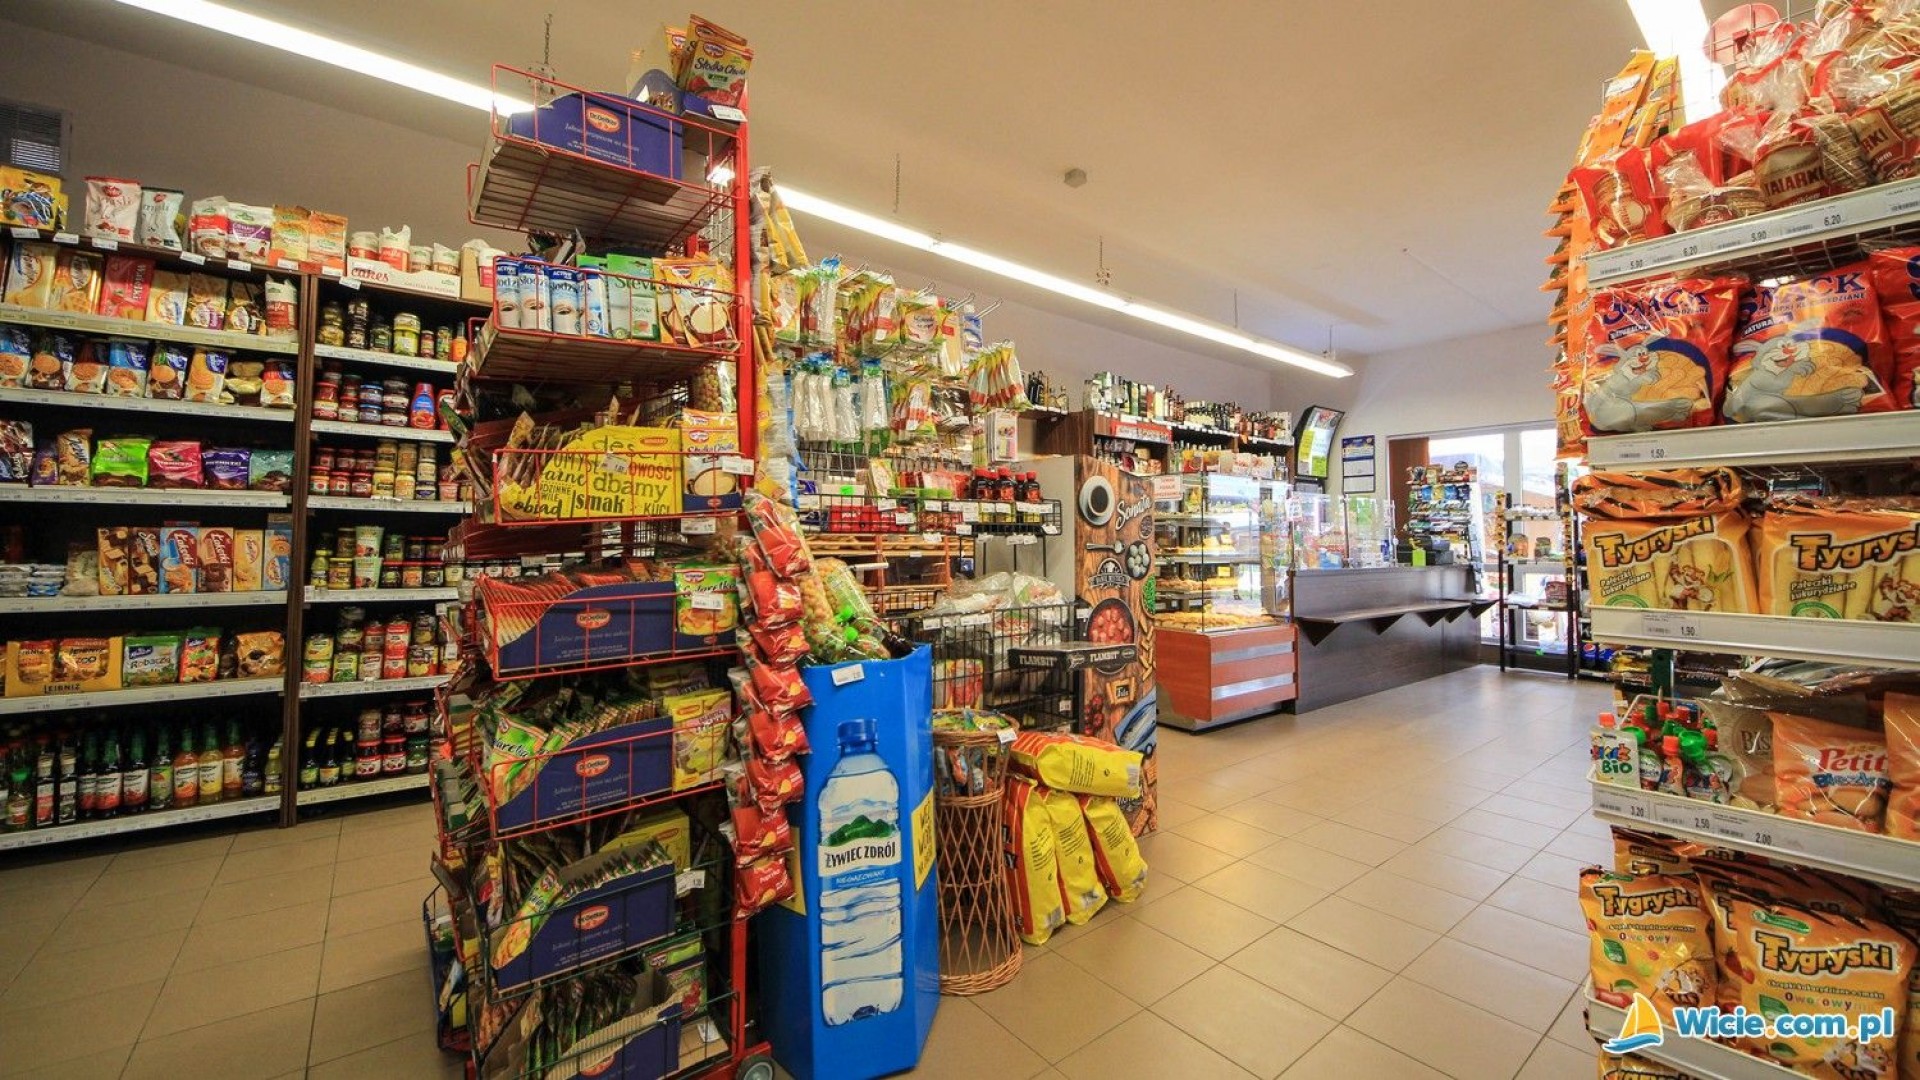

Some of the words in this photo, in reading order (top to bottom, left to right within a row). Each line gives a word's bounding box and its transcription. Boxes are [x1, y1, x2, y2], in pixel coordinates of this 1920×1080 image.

[1823, 214, 1841, 226] 6.20
[593, 472, 668, 500] dbamy
[1594, 516, 1715, 568] Tygryski
[1601, 759, 1633, 774] Bio
[1818, 746, 1888, 773] Petit
[1695, 818, 1710, 830] 2.50
[824, 846, 862, 868] ŻYWIEC
[863, 841, 896, 859] ZDRÓJ
[1594, 885, 1699, 918] Tygryski
[1755, 930, 1893, 976] Tygryski
